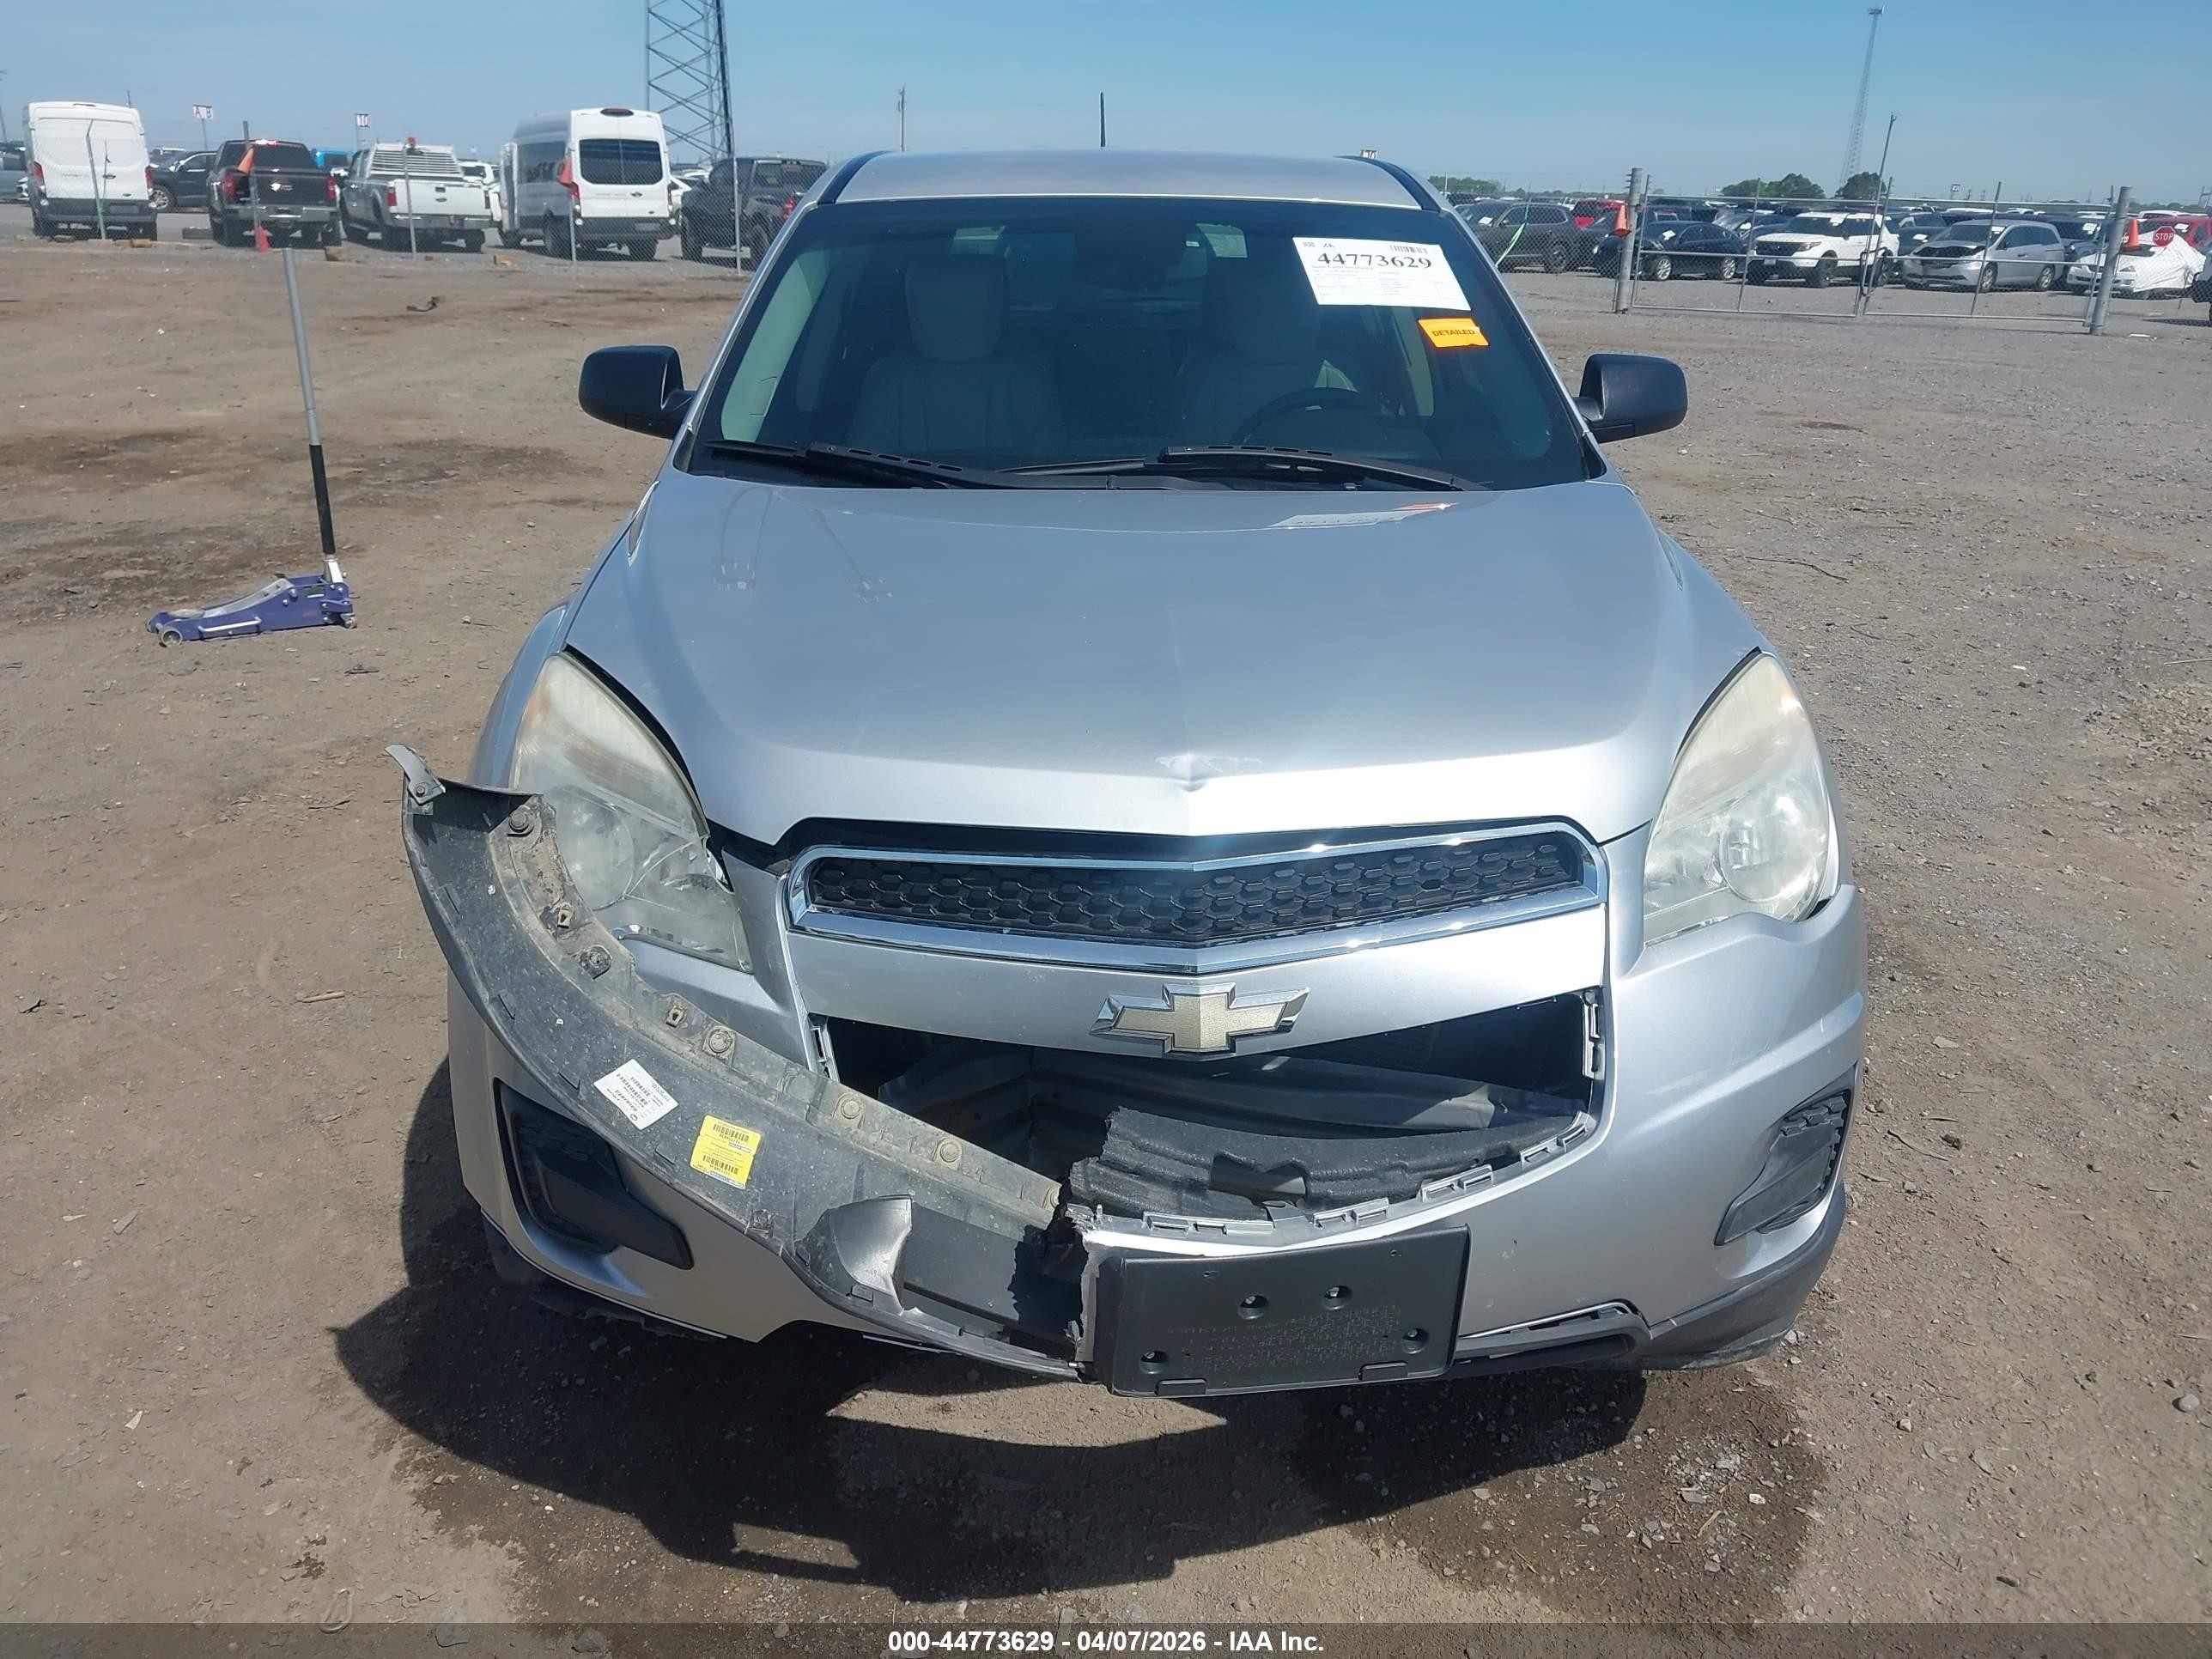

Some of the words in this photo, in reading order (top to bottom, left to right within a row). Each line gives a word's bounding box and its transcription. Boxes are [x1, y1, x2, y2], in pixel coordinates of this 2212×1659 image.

[2154, 233, 2174, 241] STOP
[1317, 252, 1432, 269] 44773629
[1431, 329, 1475, 337] DETAILED
